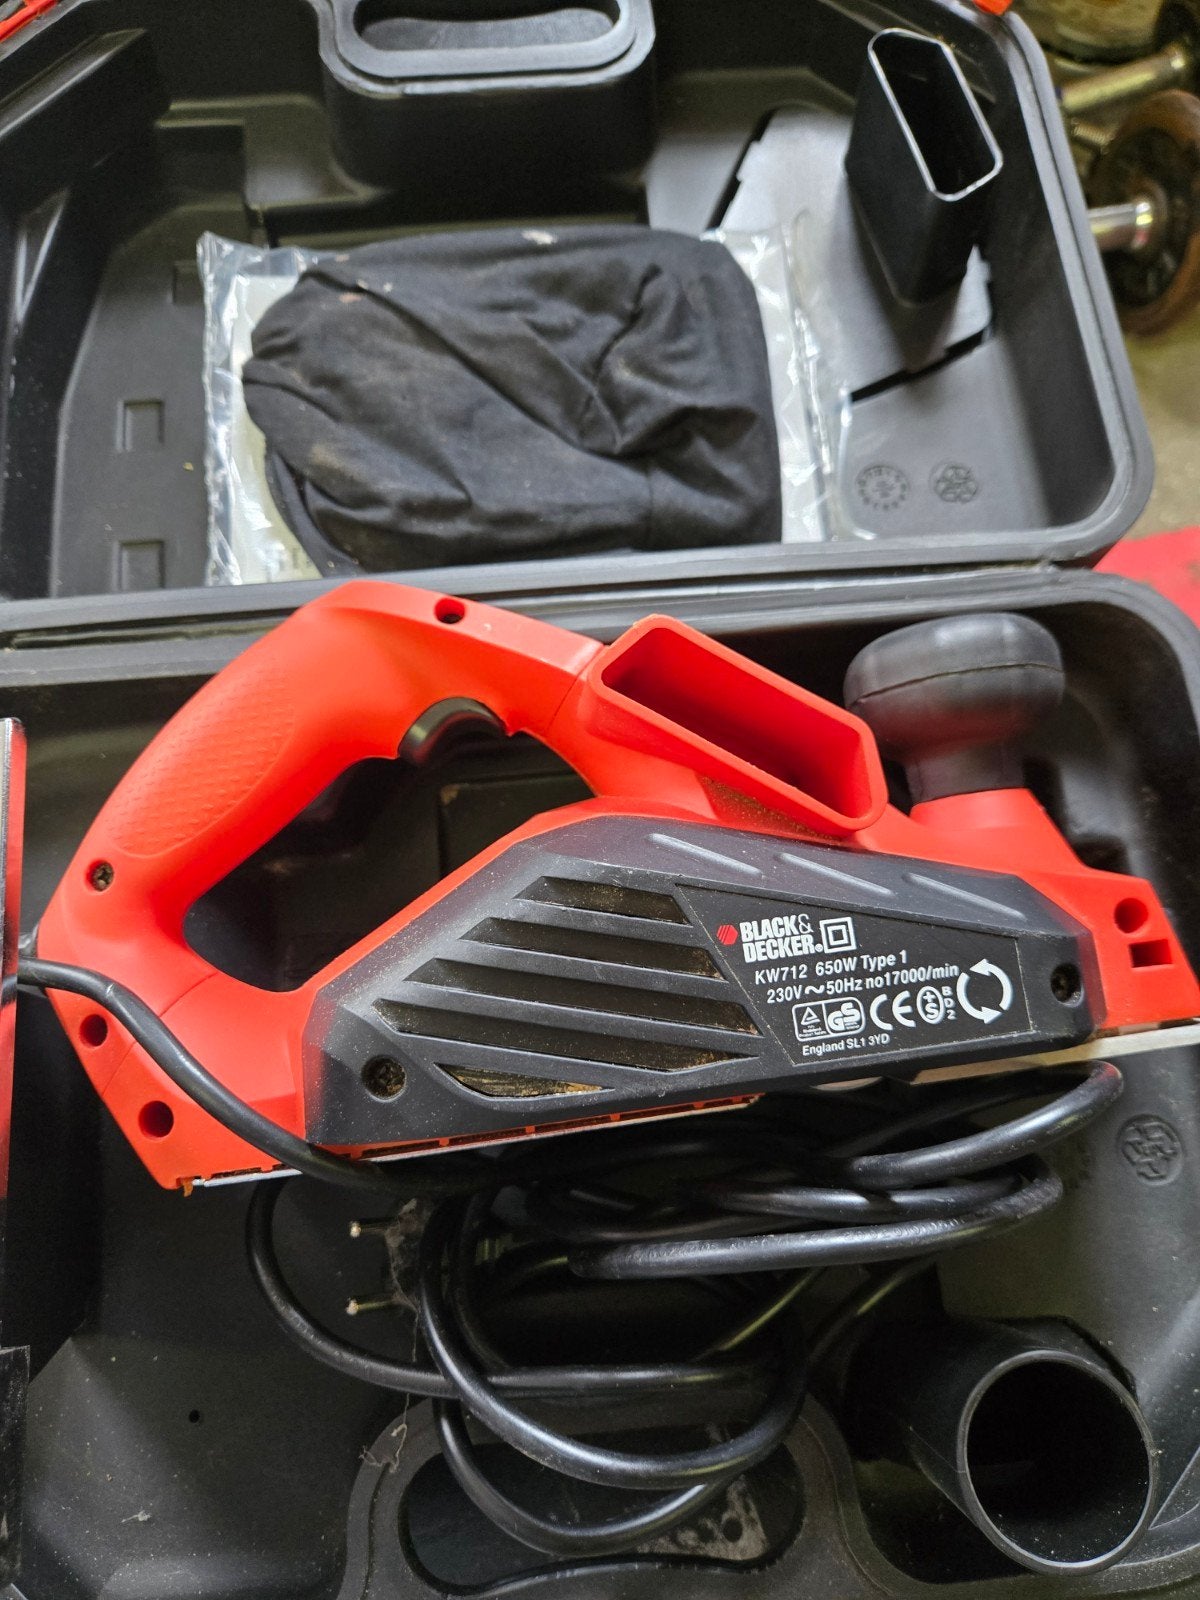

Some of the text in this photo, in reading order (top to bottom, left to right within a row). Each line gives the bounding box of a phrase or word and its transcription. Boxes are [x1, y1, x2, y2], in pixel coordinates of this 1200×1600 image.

[755, 949, 907, 985] KW712 650W Type 1
[802, 1033, 890, 1056] England SL1 3YD
